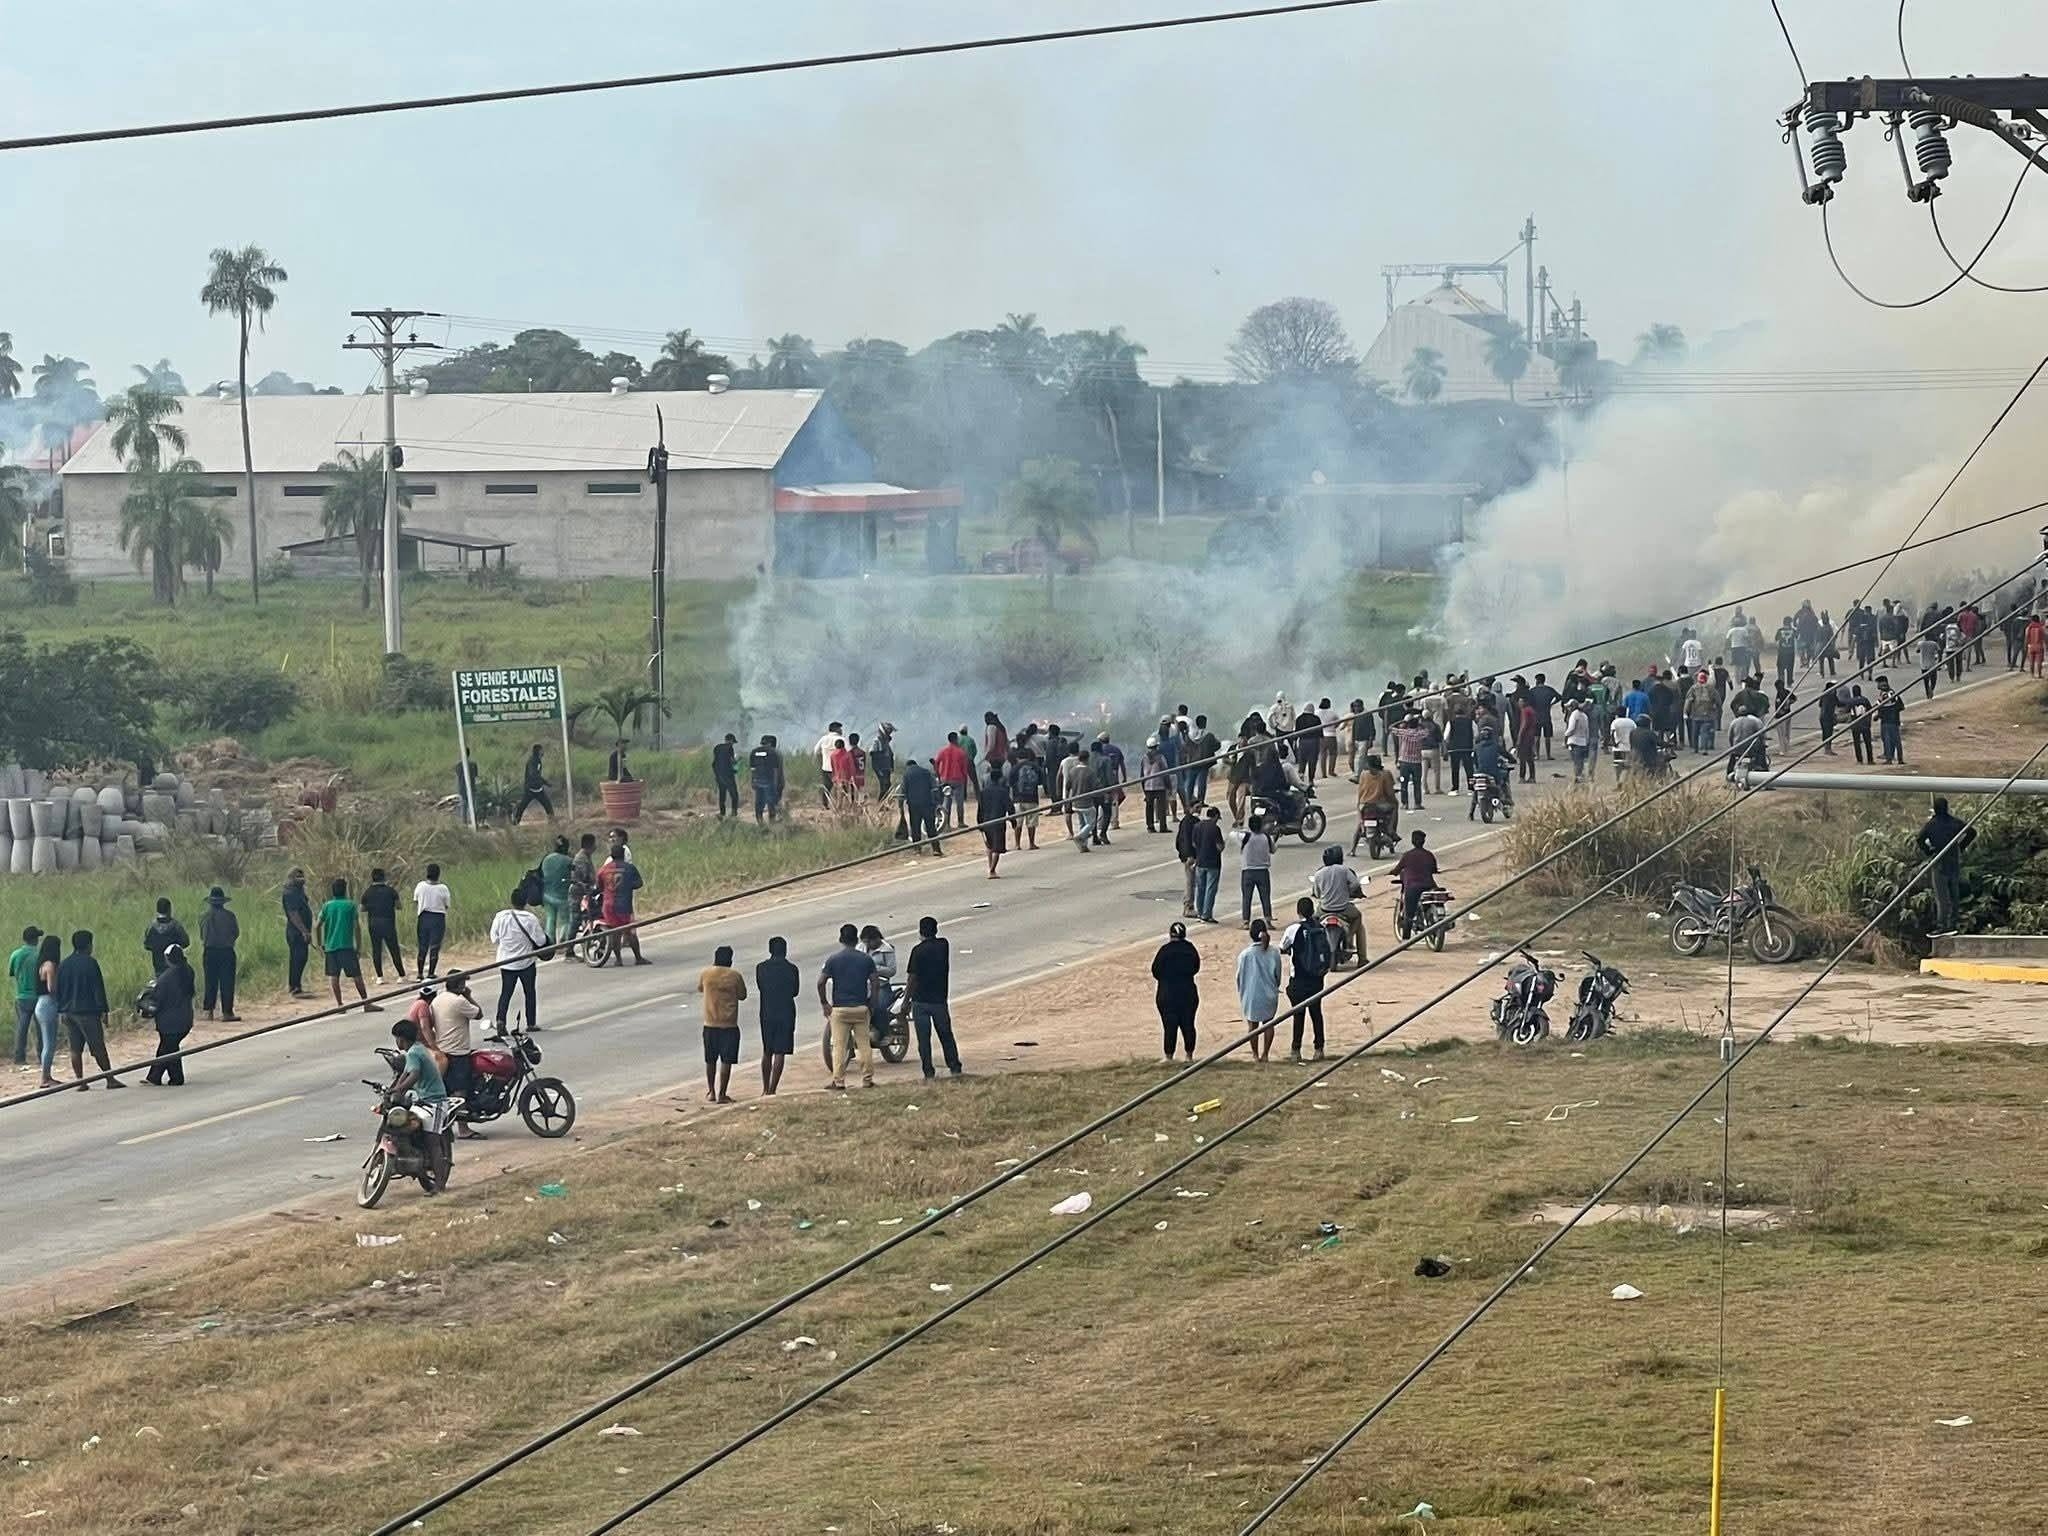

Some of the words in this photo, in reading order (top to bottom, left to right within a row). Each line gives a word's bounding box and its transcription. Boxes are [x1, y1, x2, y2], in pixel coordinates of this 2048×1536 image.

[460, 672, 473, 687] SE
[475, 671, 508, 686] VENDE
[510, 669, 555, 684] PLANTAS
[462, 686, 557, 704] FORESTALES
